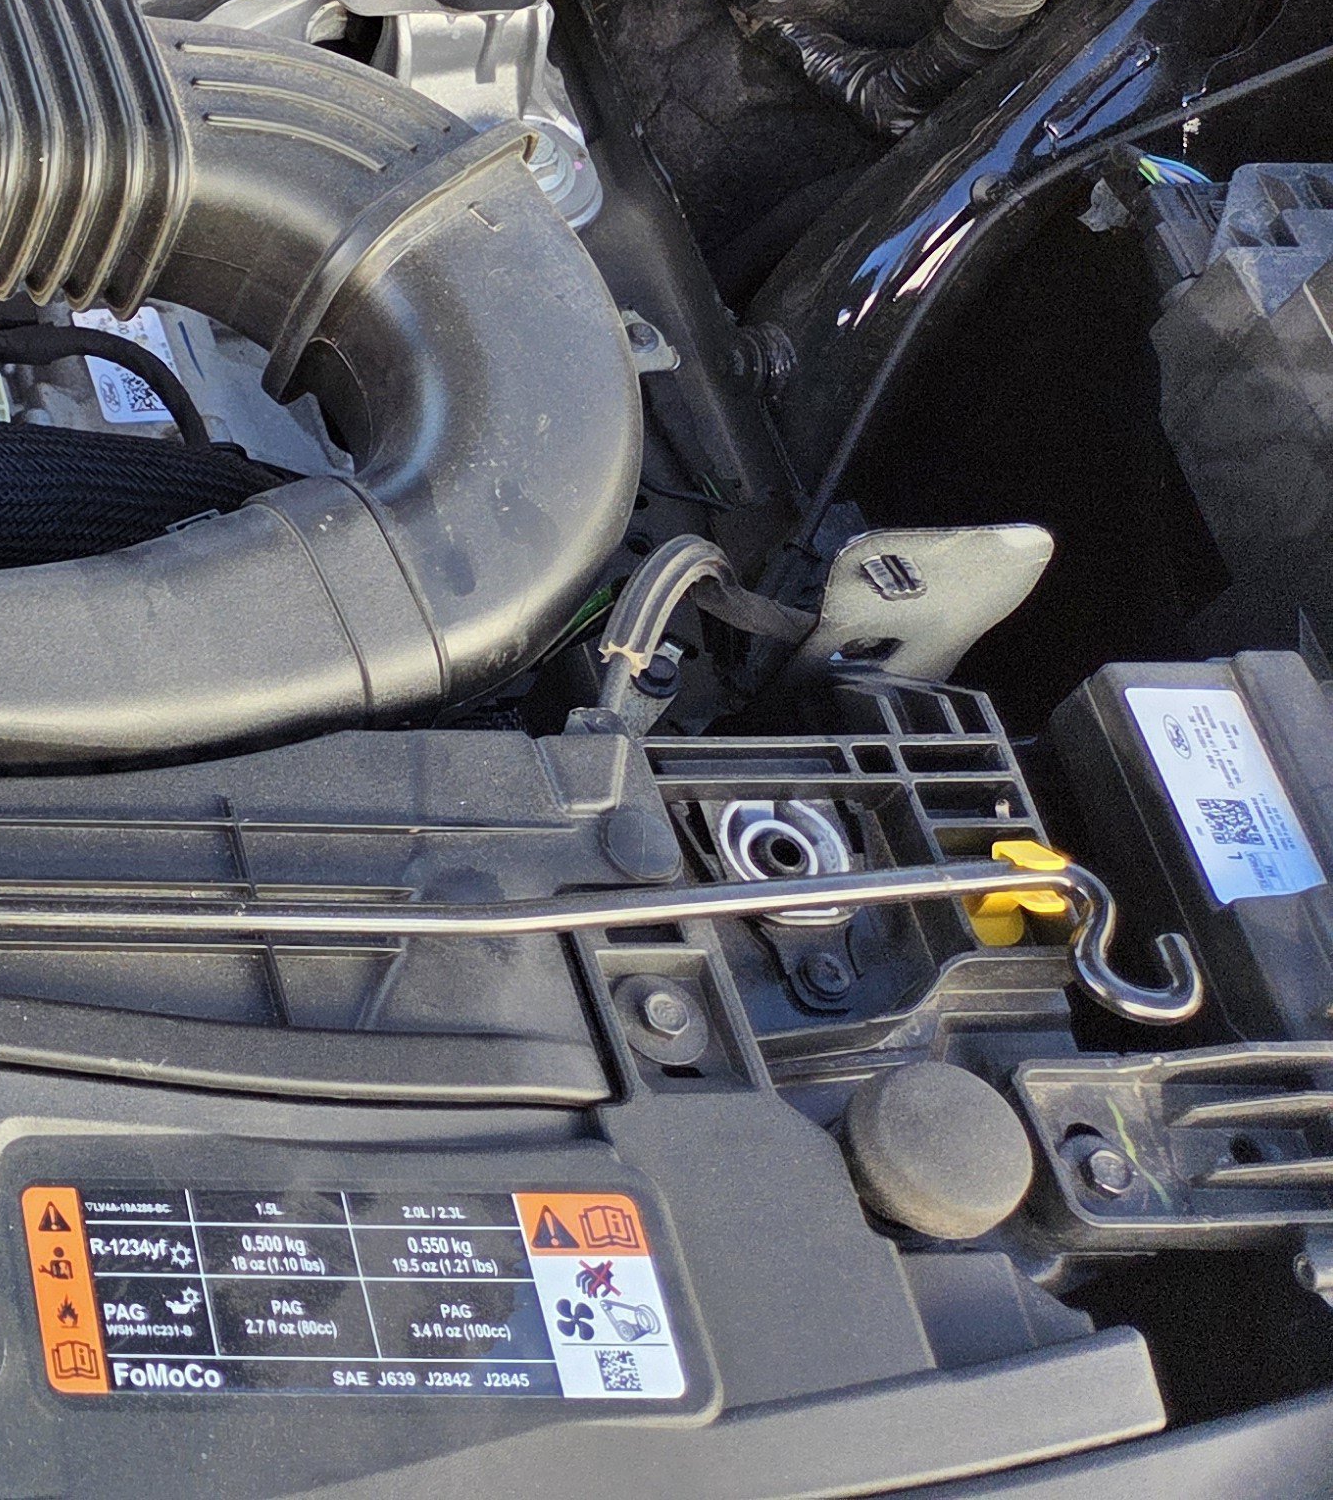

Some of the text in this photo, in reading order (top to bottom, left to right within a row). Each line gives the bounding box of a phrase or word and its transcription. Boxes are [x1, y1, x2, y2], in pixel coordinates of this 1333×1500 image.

[254, 1202, 283, 1216] 1.5L
[401, 1205, 430, 1219] 2.0L
[438, 1206, 466, 1220] 2.3L
[89, 1237, 169, 1260] R-1234yf
[241, 1235, 307, 1257] 0.500 kg
[406, 1236, 472, 1258] 0.550 kg
[232, 1256, 326, 1276] 18 oz (1.10 lbs)
[392, 1258, 499, 1277] 19.5 oz (1.21 lbs)
[102, 1302, 147, 1321] PAG
[270, 1299, 305, 1316] PAG
[439, 1303, 473, 1319] PAG
[244, 1318, 265, 1335] 2.7
[279, 1322, 296, 1335] oz
[410, 1322, 432, 1339] 3.4
[445, 1326, 463, 1339] oz
[463, 1323, 512, 1342] (100cc)
[113, 1362, 222, 1388] FoMoCo
[332, 1370, 531, 1388] SAE J639 J2842 J2845
